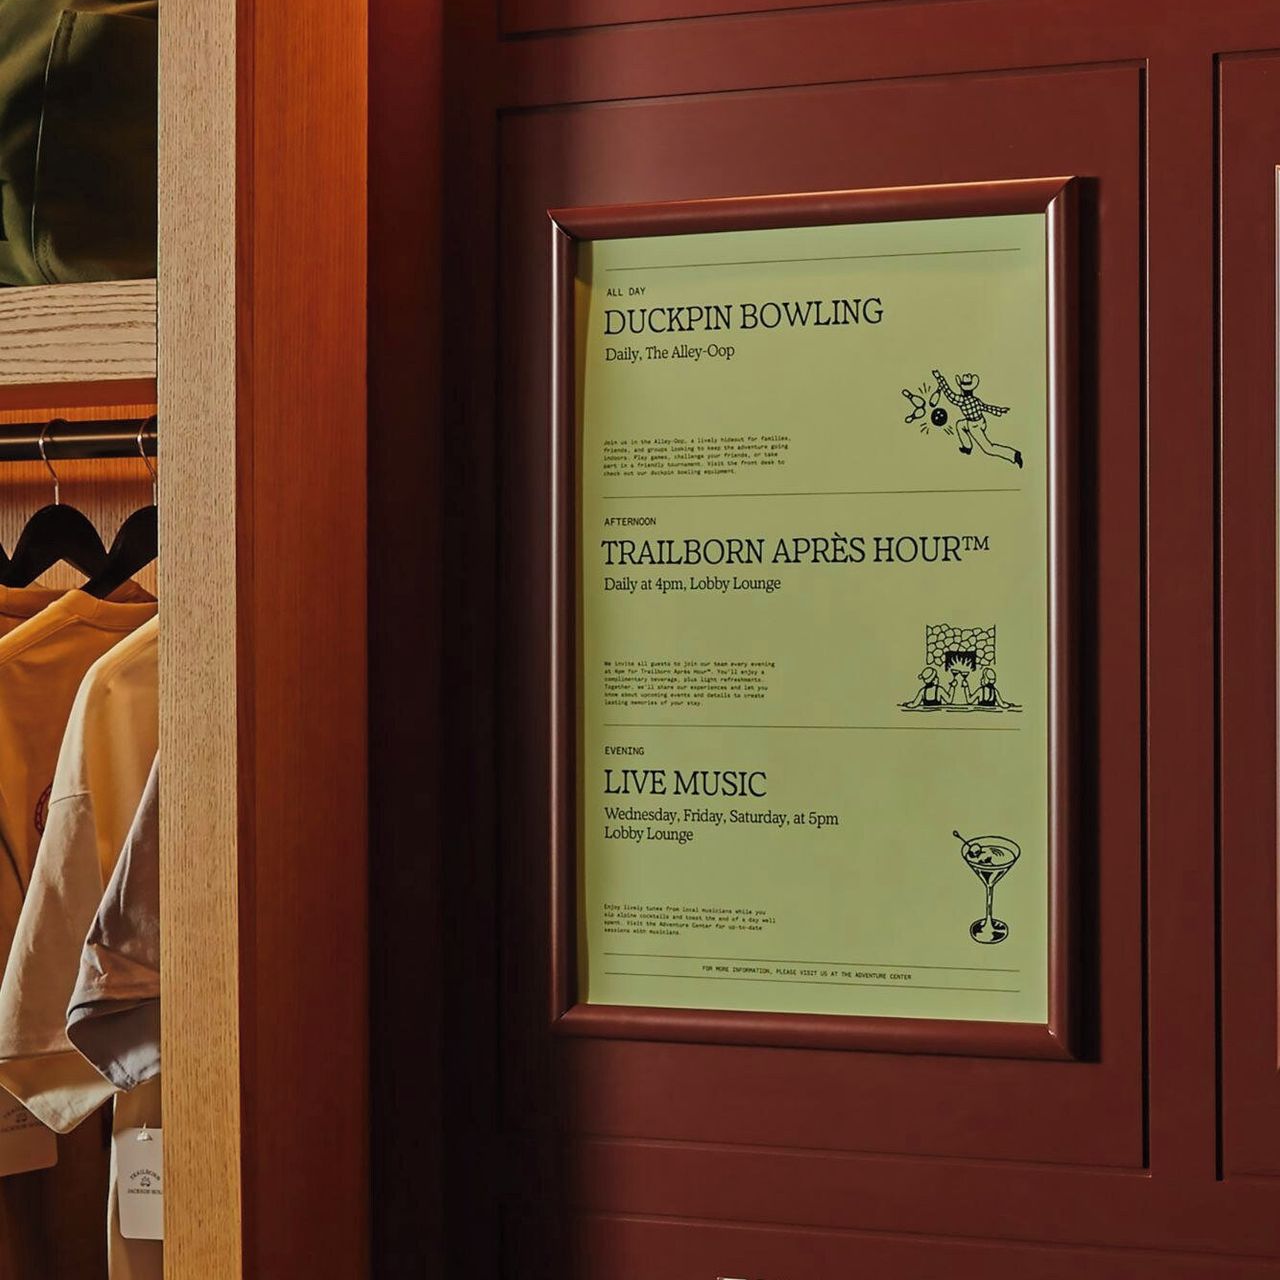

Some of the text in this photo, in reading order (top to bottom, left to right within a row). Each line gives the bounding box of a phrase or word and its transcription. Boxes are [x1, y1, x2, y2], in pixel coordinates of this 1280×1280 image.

[606, 287, 646, 297] ALL DAY
[604, 297, 884, 335] DUCKPIN BOWLING
[605, 344, 735, 364] Daily, The Alley-Oop
[604, 517, 657, 526] AFTERNOON
[600, 532, 990, 565] TRAILBORN APRÈS HOUR™
[604, 576, 781, 594] Daily at 4pm, Lobby Lounge
[604, 746, 645, 756] EVENING
[604, 769, 767, 797] LIVE MUSIC
[604, 807, 839, 827] Wednesday, Friday, Saturday, at 5pm
[604, 825, 694, 844] Lobby Lounge
[732, 966, 773, 975] INFORMATION,
[775, 968, 797, 976] PLEASE
